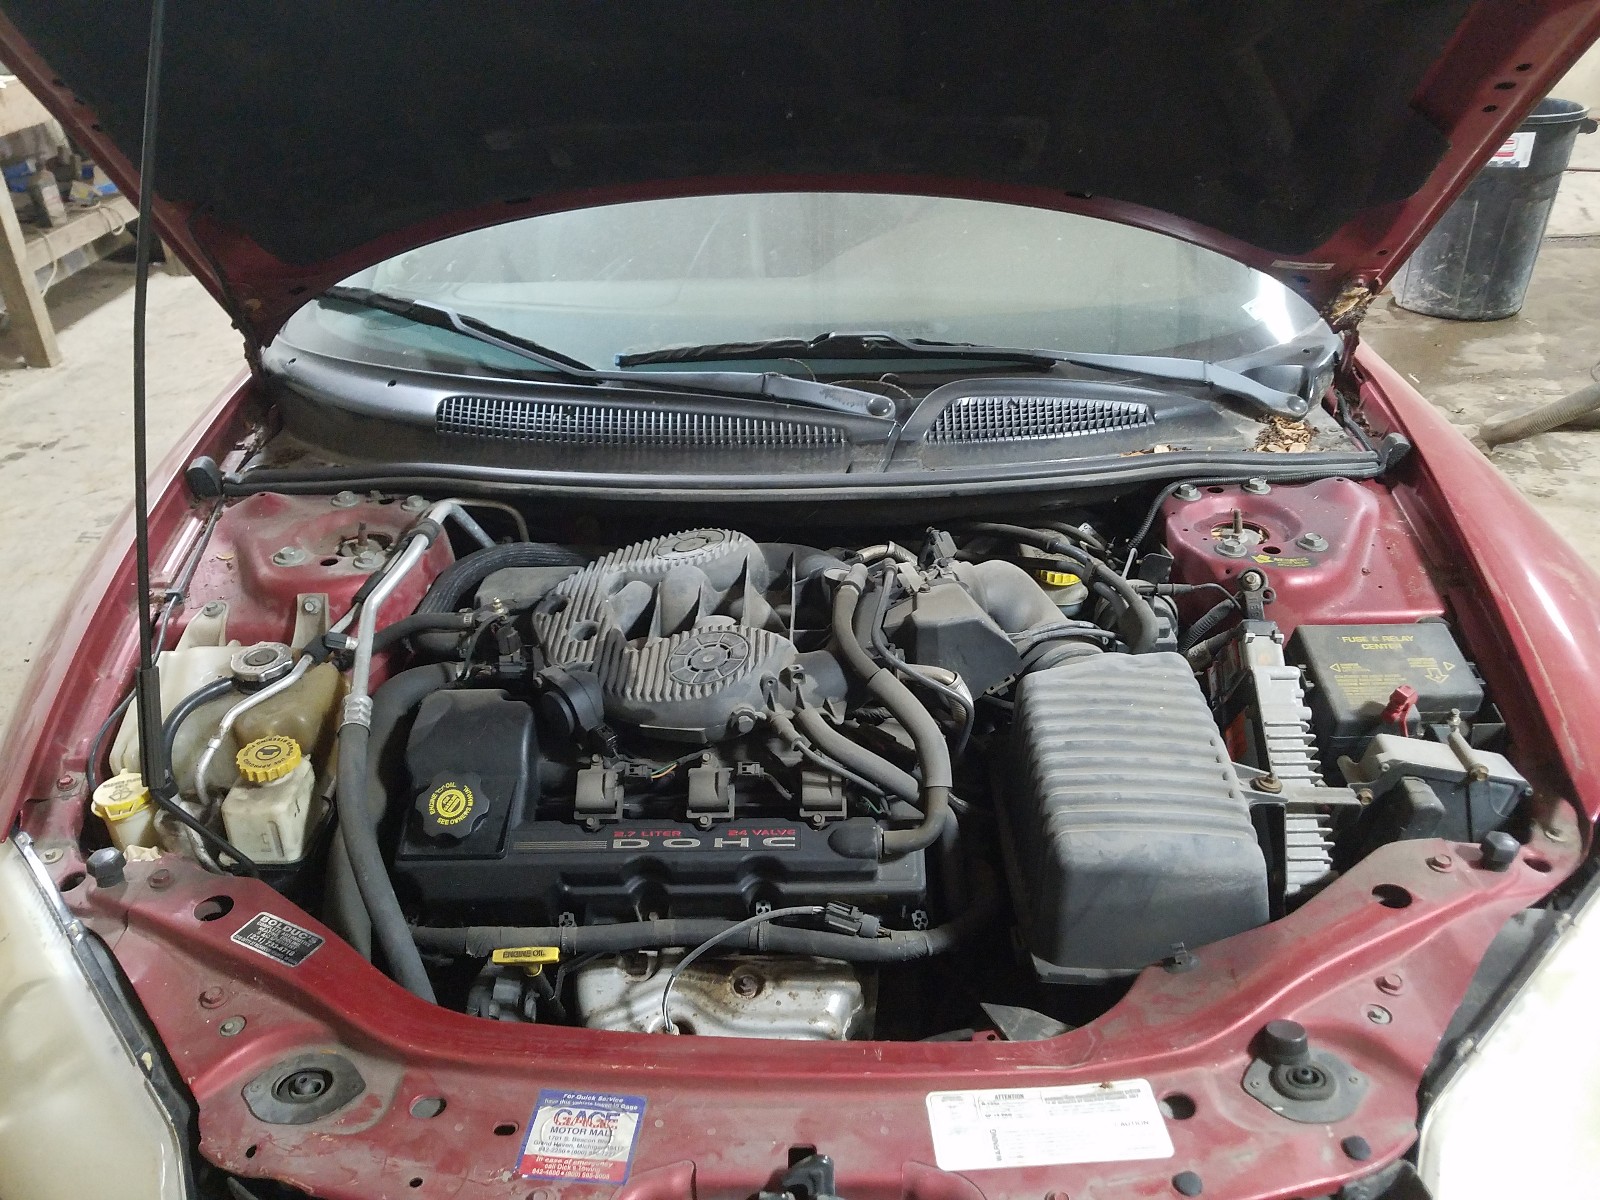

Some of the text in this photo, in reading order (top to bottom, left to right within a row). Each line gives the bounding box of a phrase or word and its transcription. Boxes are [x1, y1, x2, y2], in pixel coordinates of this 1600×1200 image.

[612, 837, 796, 849] DOHC
[503, 949, 545, 959] ENGINE OIL
[553, 1108, 620, 1130] GAGE
[551, 1127, 587, 1135] MOTOR
